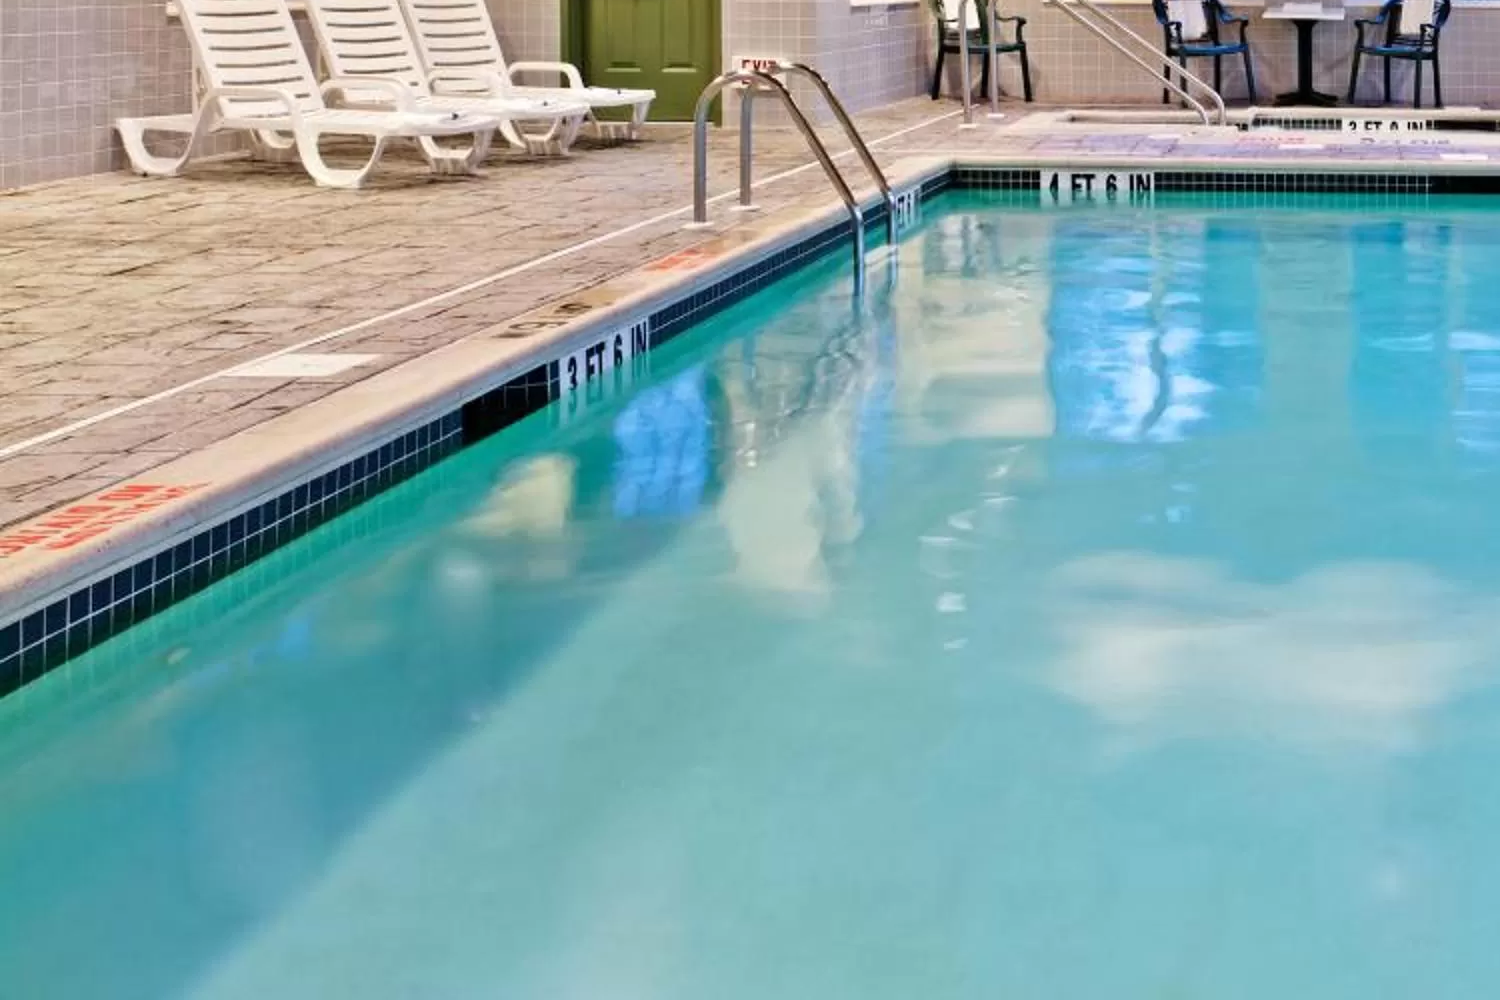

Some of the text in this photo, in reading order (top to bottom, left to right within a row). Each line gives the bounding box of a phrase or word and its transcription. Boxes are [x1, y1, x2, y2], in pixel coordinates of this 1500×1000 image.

[1070, 173, 1096, 192] FT
[1105, 173, 1118, 192] 6
[1128, 173, 1151, 192] IN
[585, 341, 606, 382] FT
[613, 333, 623, 367] 6
[631, 320, 647, 360] IN
